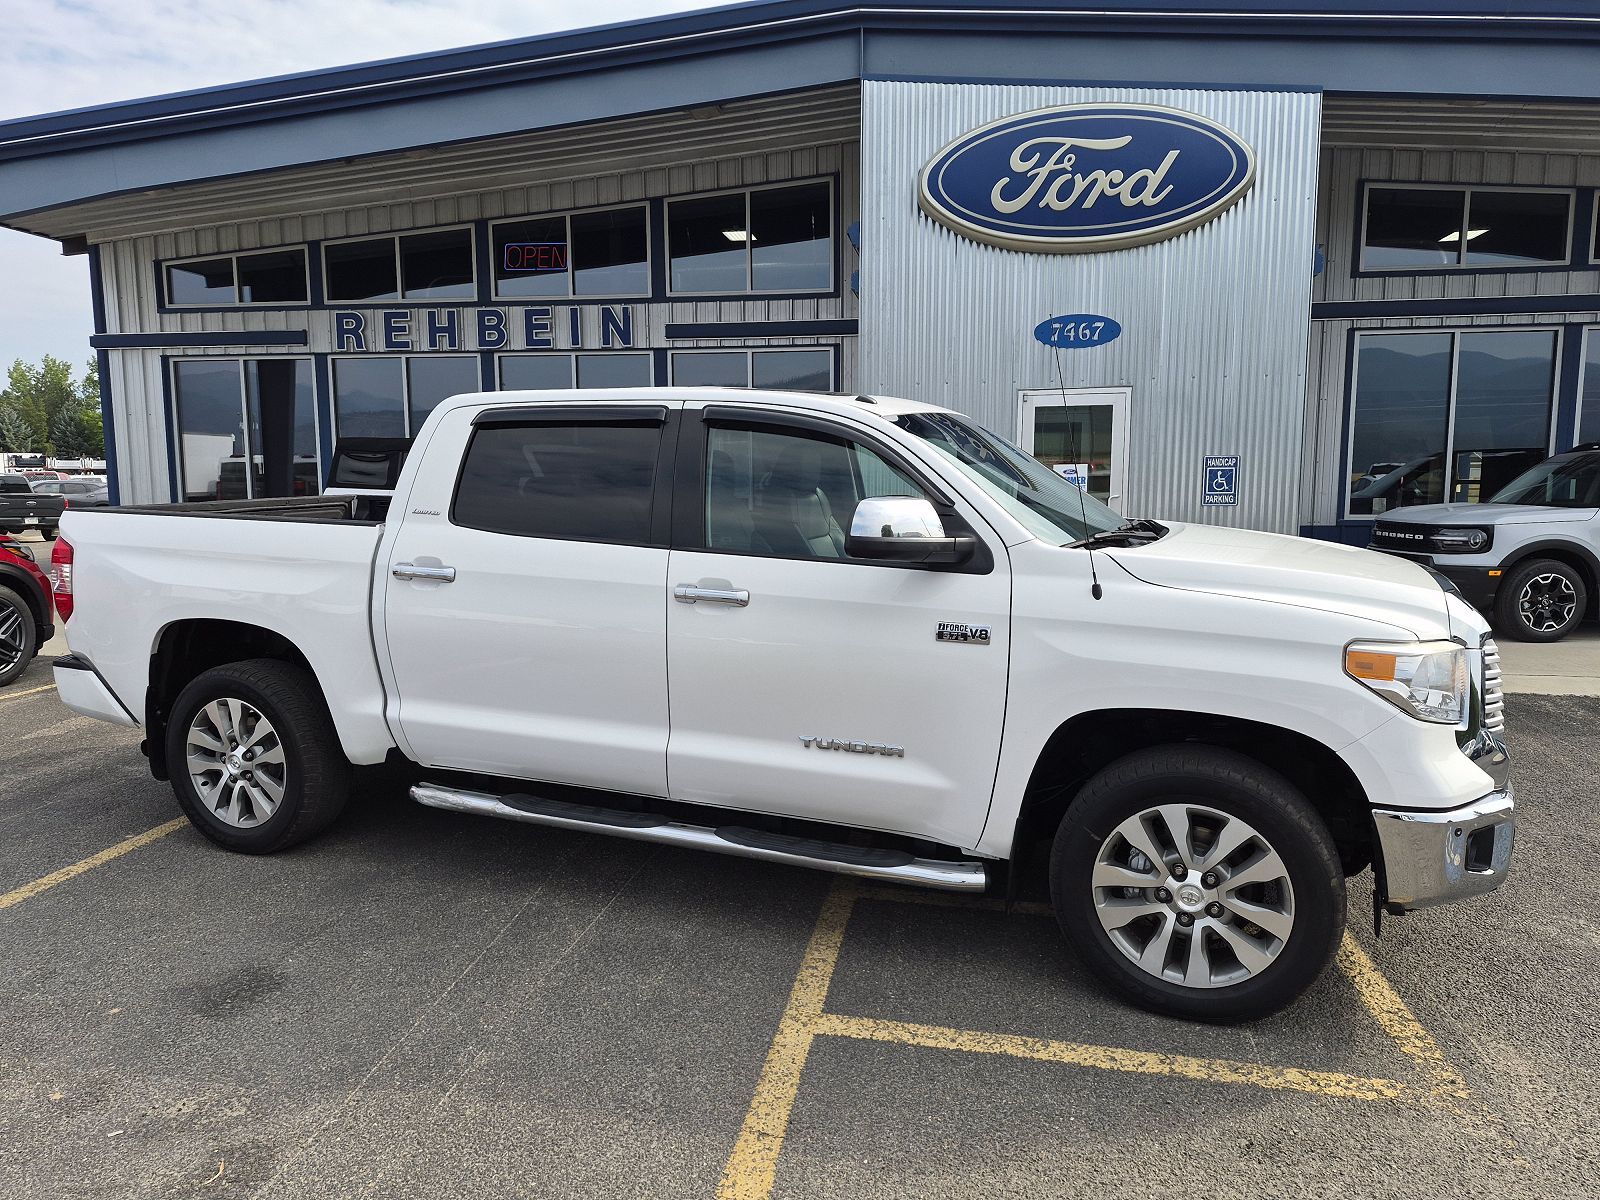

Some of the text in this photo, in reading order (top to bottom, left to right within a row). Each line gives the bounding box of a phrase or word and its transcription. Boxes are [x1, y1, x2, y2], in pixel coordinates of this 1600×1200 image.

[991, 135, 1180, 214] Ford
[507, 246, 566, 267] OPEN
[334, 305, 633, 351] REHBEIN
[1051, 321, 1105, 341] 7467
[1207, 458, 1236, 466] HANDICAP
[1205, 495, 1234, 503] PARKING
[1376, 530, 1424, 540] BRONCO
[970, 628, 989, 641] V8
[799, 735, 904, 757] TUNDRA
